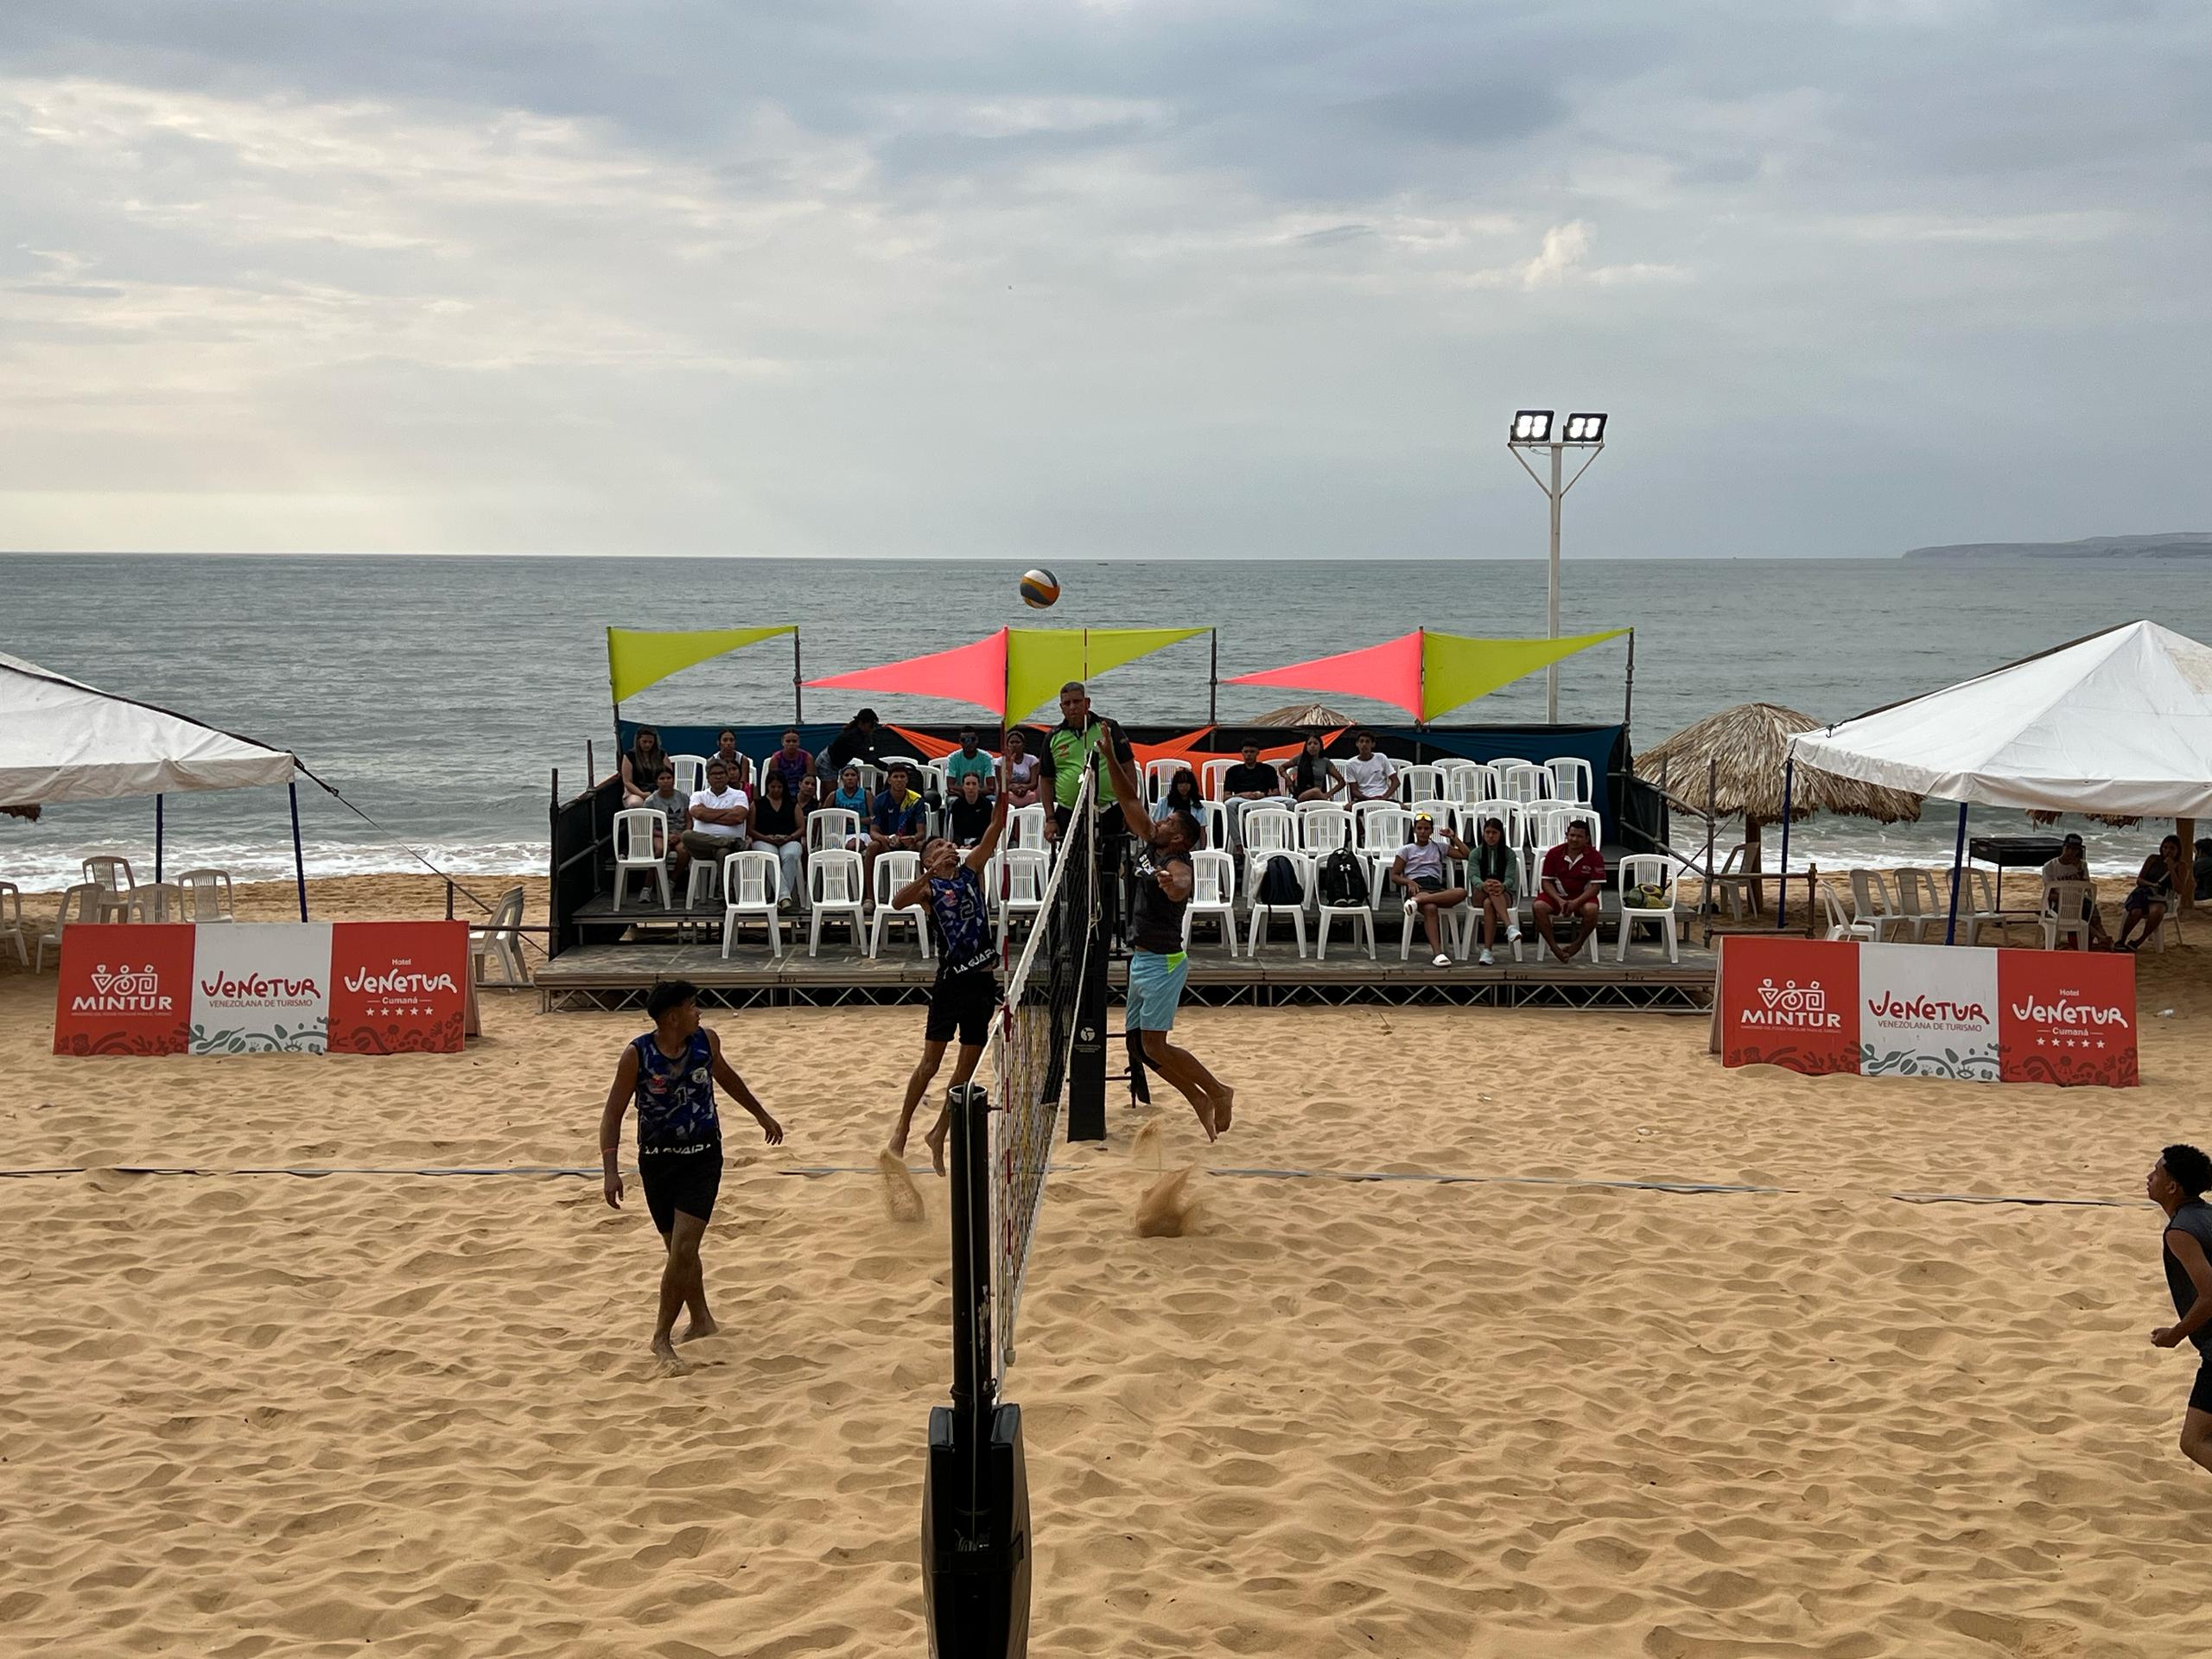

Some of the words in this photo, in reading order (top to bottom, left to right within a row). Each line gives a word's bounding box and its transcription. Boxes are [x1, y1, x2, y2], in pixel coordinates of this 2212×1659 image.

[953, 963, 968, 974] LA
[72, 996, 173, 1010] MINTUR
[1741, 1009, 1840, 1027] MINTUR
[1878, 1020, 1931, 1030] VENEZOLANA
[1933, 1022, 1943, 1031] DE
[1946, 1023, 1982, 1033] TURISMO
[2052, 1027, 2088, 1036] Cumaná
